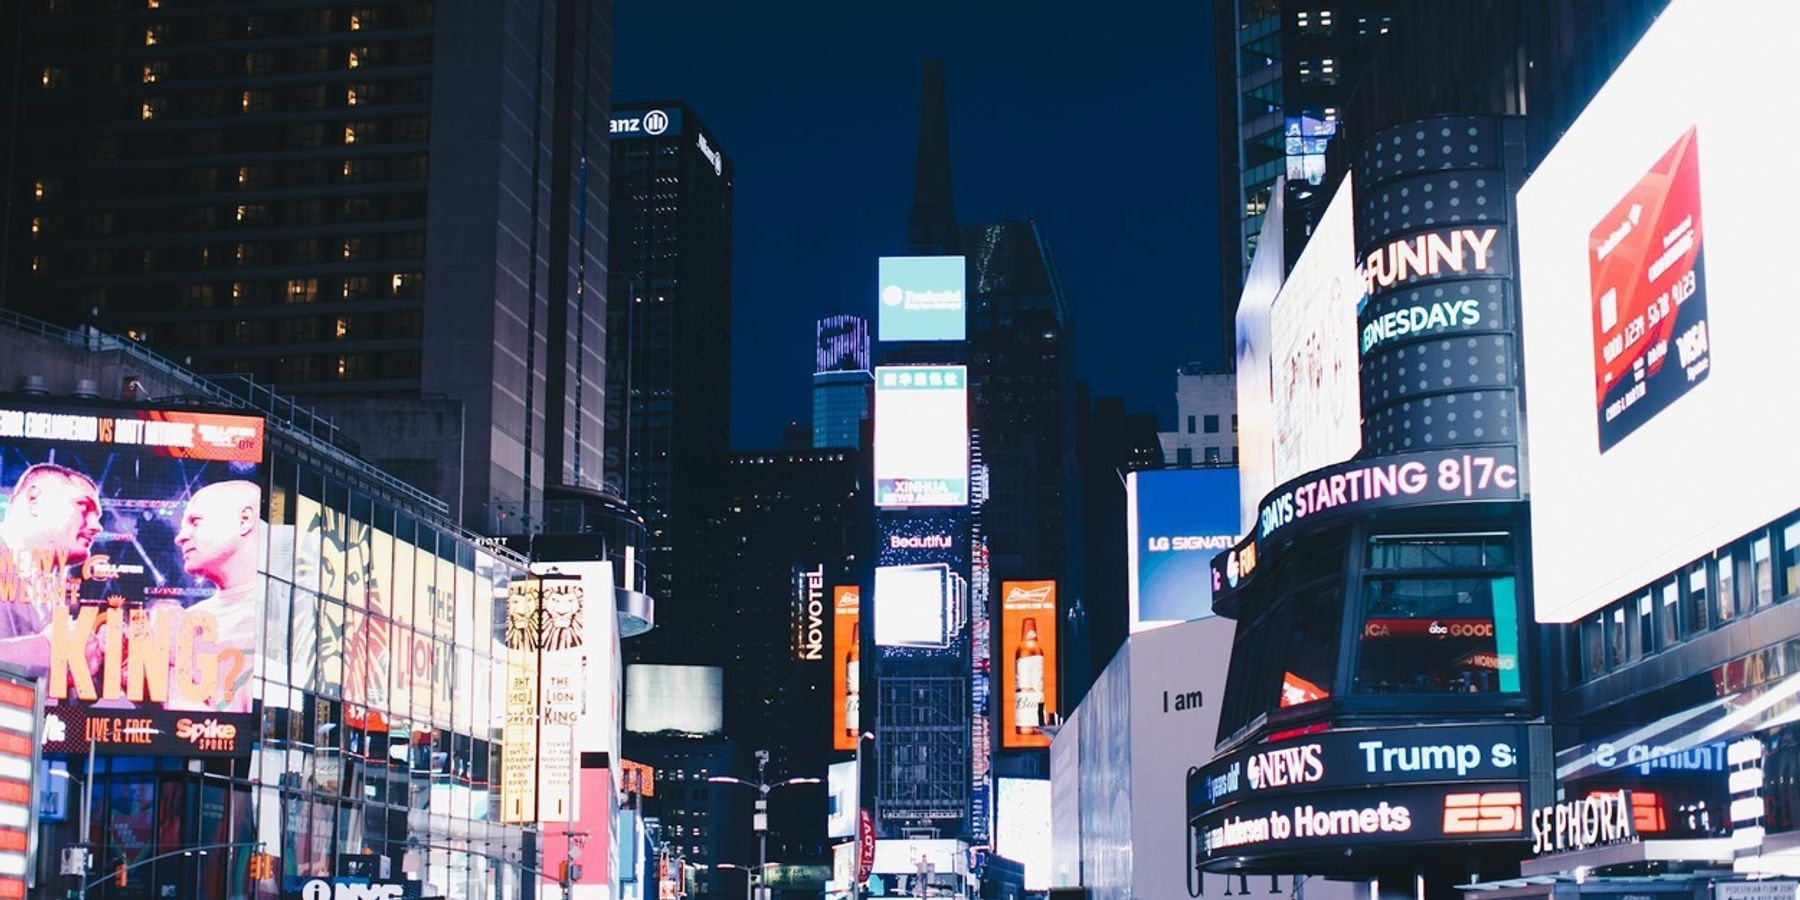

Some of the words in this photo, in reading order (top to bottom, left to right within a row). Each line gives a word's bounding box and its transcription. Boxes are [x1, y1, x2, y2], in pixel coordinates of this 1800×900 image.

[1366, 228, 1497, 294] FUNNY
[99, 417, 114, 443] VS
[1295, 461, 1428, 518] STARTING
[891, 534, 952, 549] Beautiful
[1149, 537, 1169, 551] LG
[806, 564, 824, 660] NOVOTEL
[551, 677, 568, 686] THE
[1164, 691, 1168, 712] I
[1175, 690, 1202, 711] am
[544, 706, 577, 726] KING
[85, 717, 110, 742] LIVE
[176, 717, 236, 744] Spike
[199, 738, 234, 750] SPORTS
[1258, 743, 1324, 788] NEWS
[1359, 741, 1481, 775] Trump
[1270, 810, 1291, 839] to
[1295, 802, 1410, 837] Hornets
[1531, 788, 1631, 854] SEPHORA
